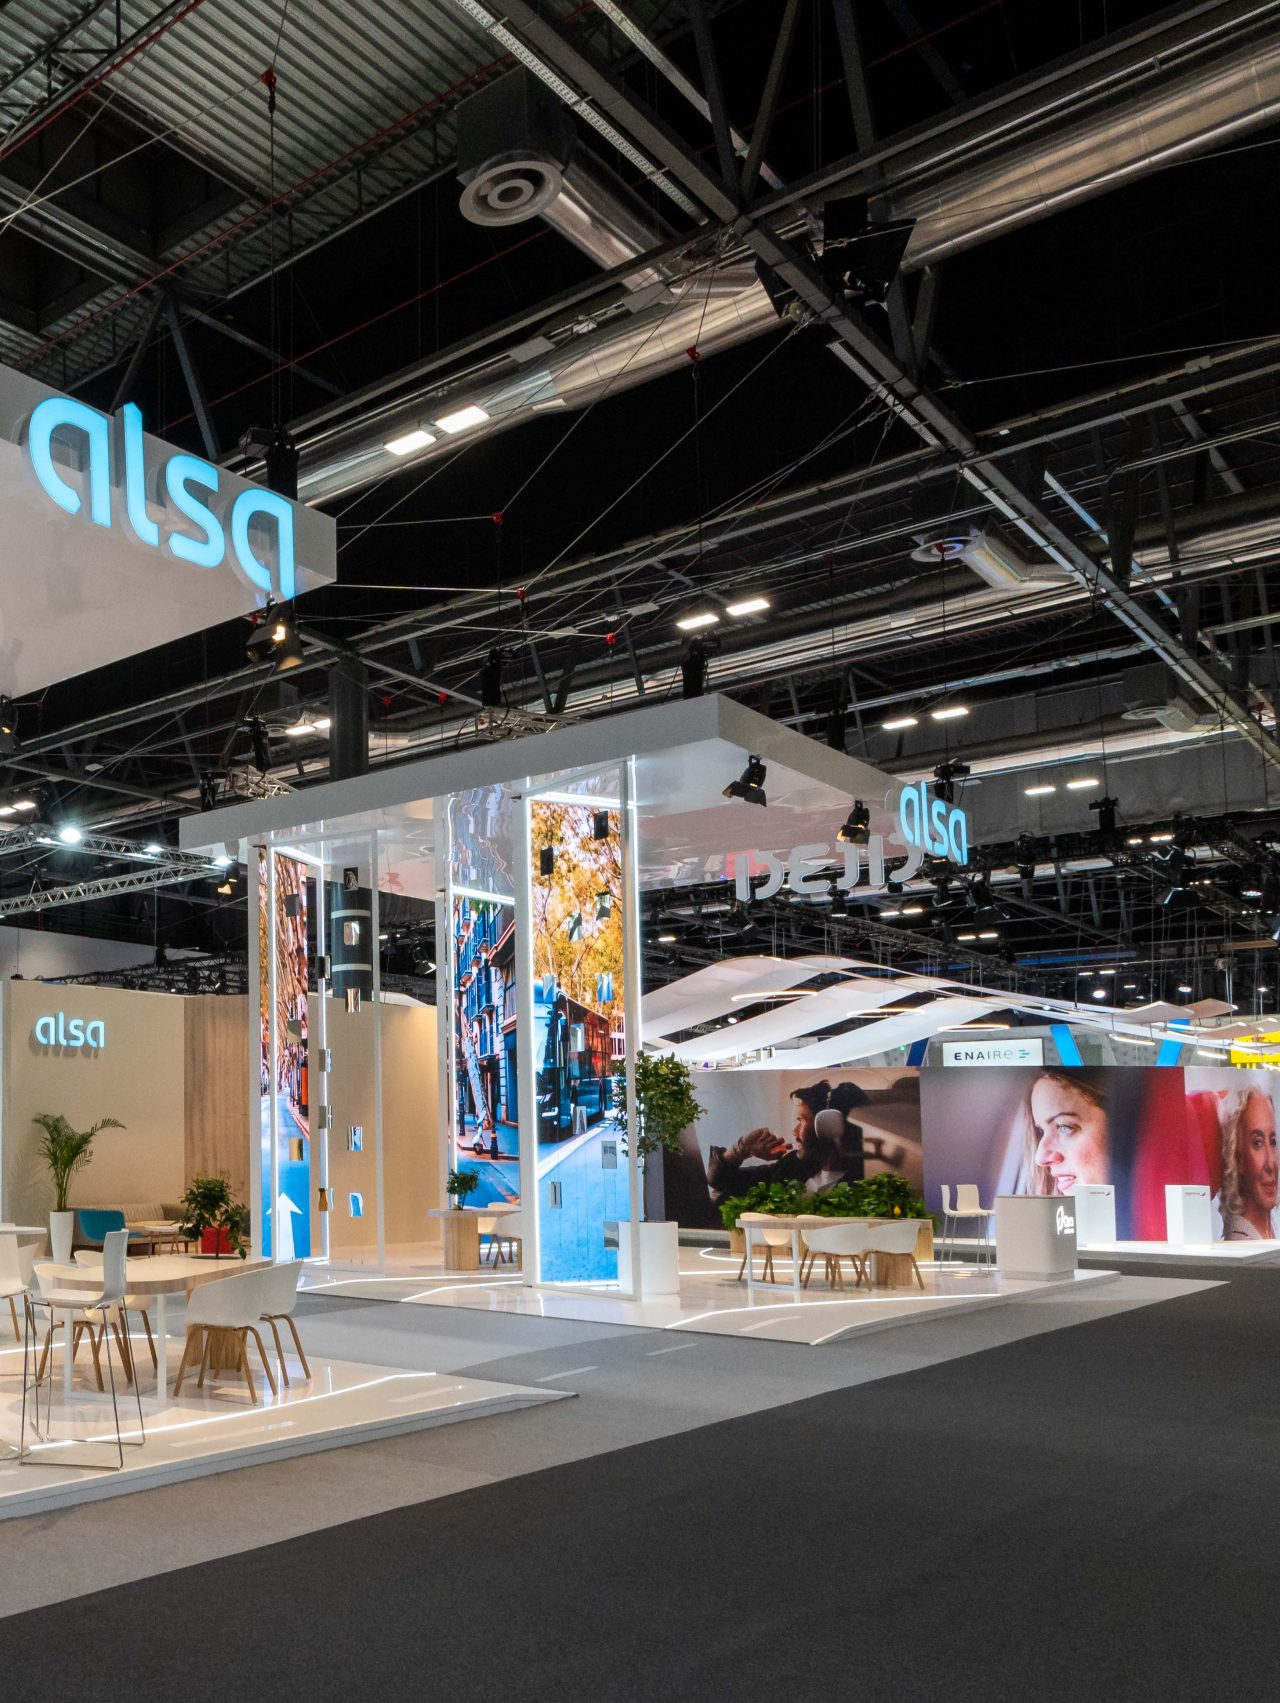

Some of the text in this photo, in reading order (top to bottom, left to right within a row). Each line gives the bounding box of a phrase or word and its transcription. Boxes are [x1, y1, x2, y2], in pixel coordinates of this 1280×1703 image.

[28, 397, 296, 602] alsa
[900, 780, 968, 865] alsa
[35, 1011, 105, 1048] alsa
